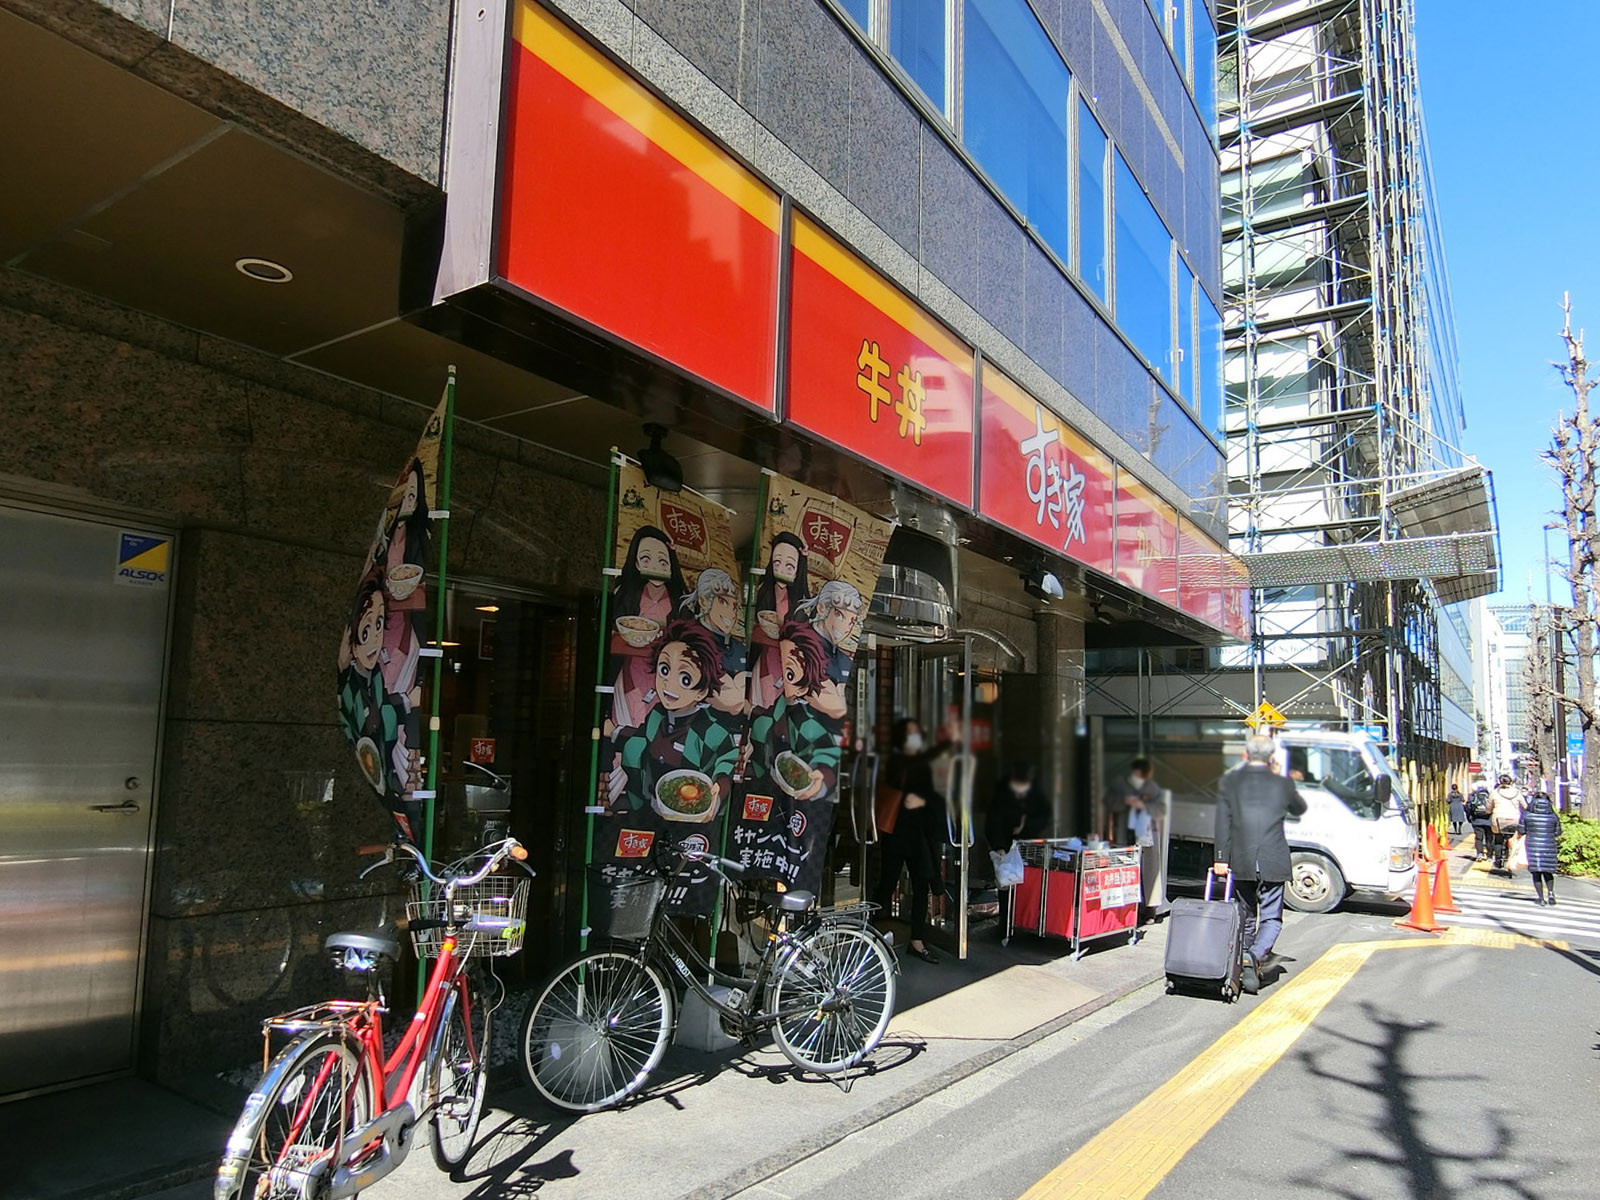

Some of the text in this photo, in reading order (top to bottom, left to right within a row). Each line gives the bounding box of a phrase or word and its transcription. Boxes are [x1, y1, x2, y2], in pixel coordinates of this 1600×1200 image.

[857, 338, 1087, 550] 牛丼 すき家
[665, 507, 703, 541] すき家
[808, 515, 844, 553] すき家
[118, 568, 165, 582] ALSOK
[623, 833, 649, 850] すき家
[734, 825, 810, 861] キャンペーン
[740, 847, 800, 884] 実施中!!
